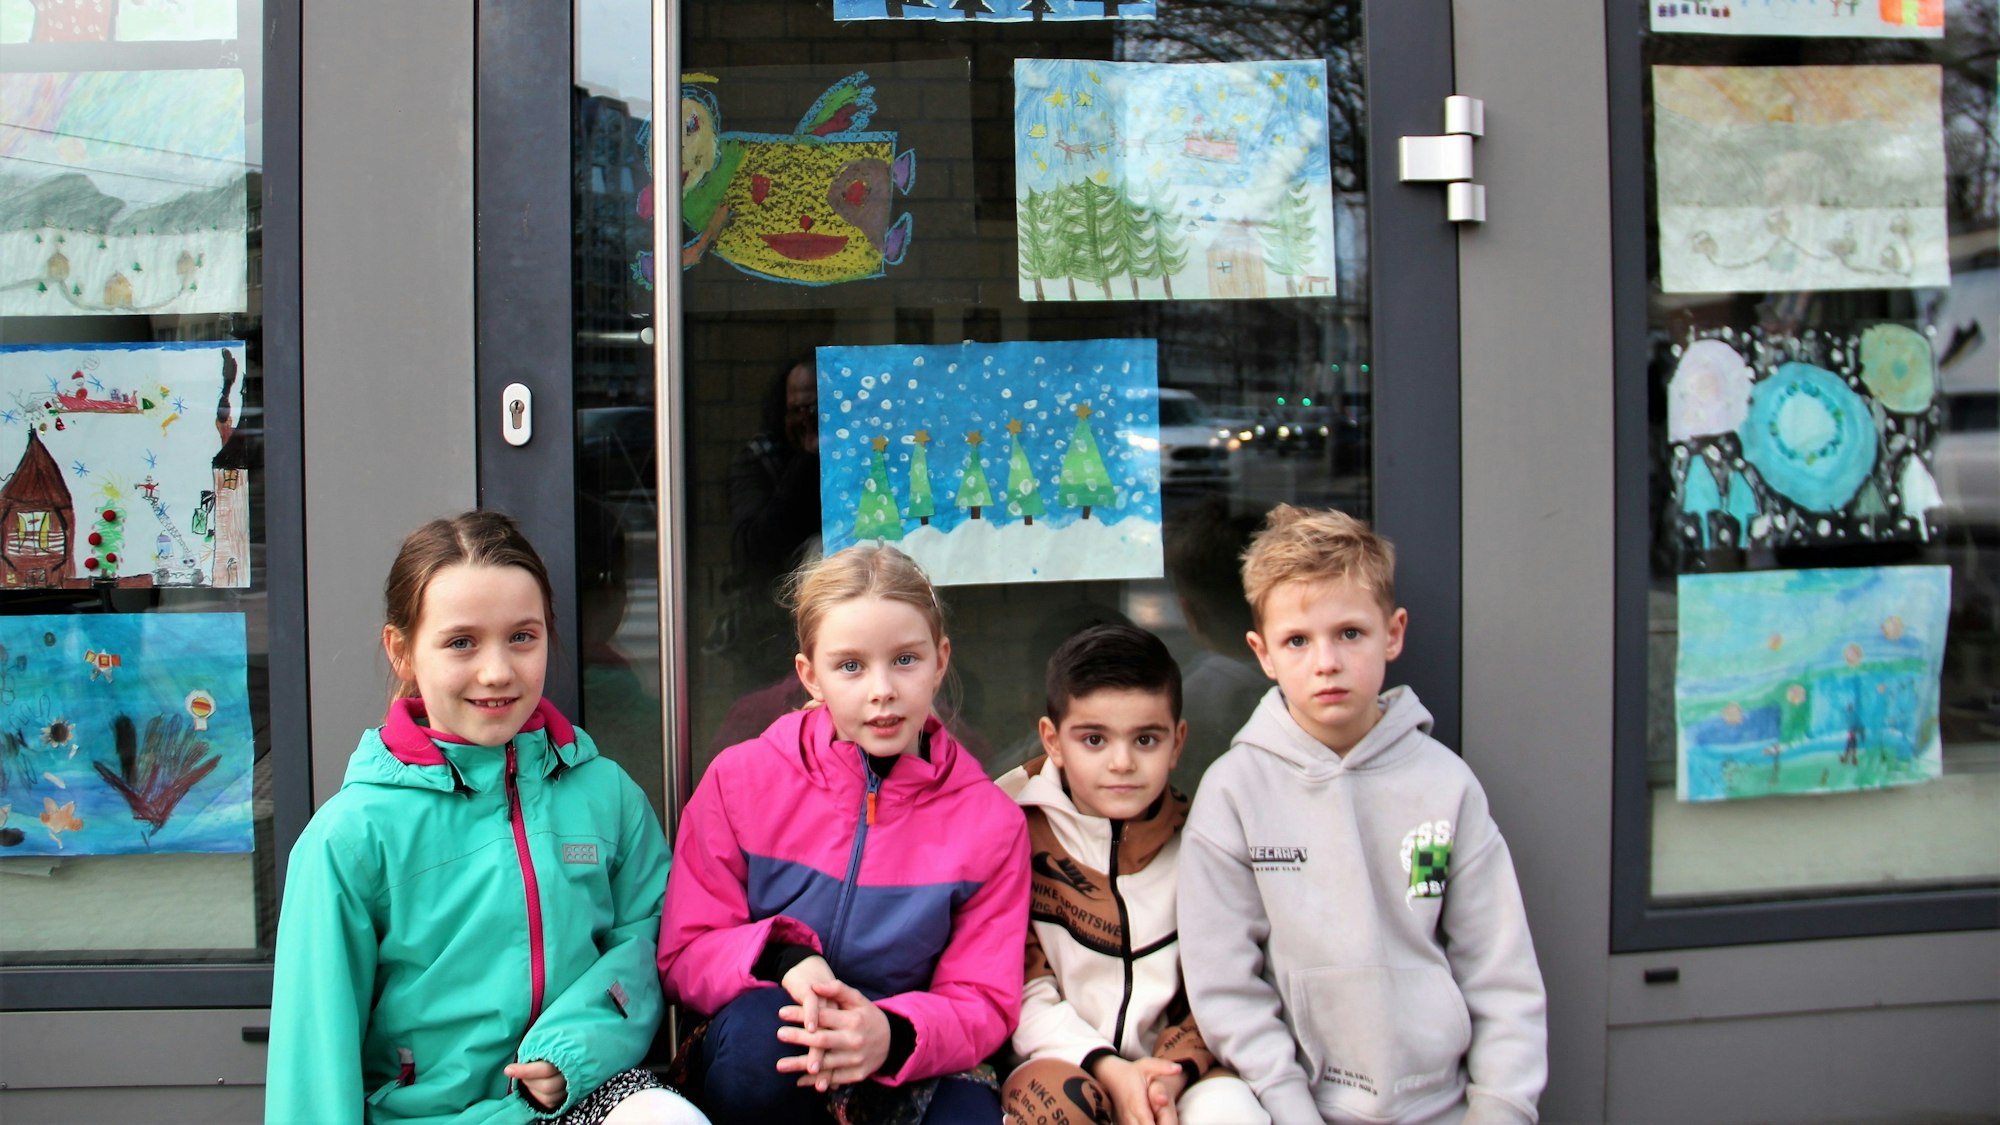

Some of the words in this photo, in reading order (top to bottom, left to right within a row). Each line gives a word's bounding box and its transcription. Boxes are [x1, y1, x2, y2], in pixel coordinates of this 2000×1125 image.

[1032, 881, 1059, 899] NIKE
[1027, 1078, 1056, 1109] NIKE
[1021, 1094, 1036, 1117] Inc.
